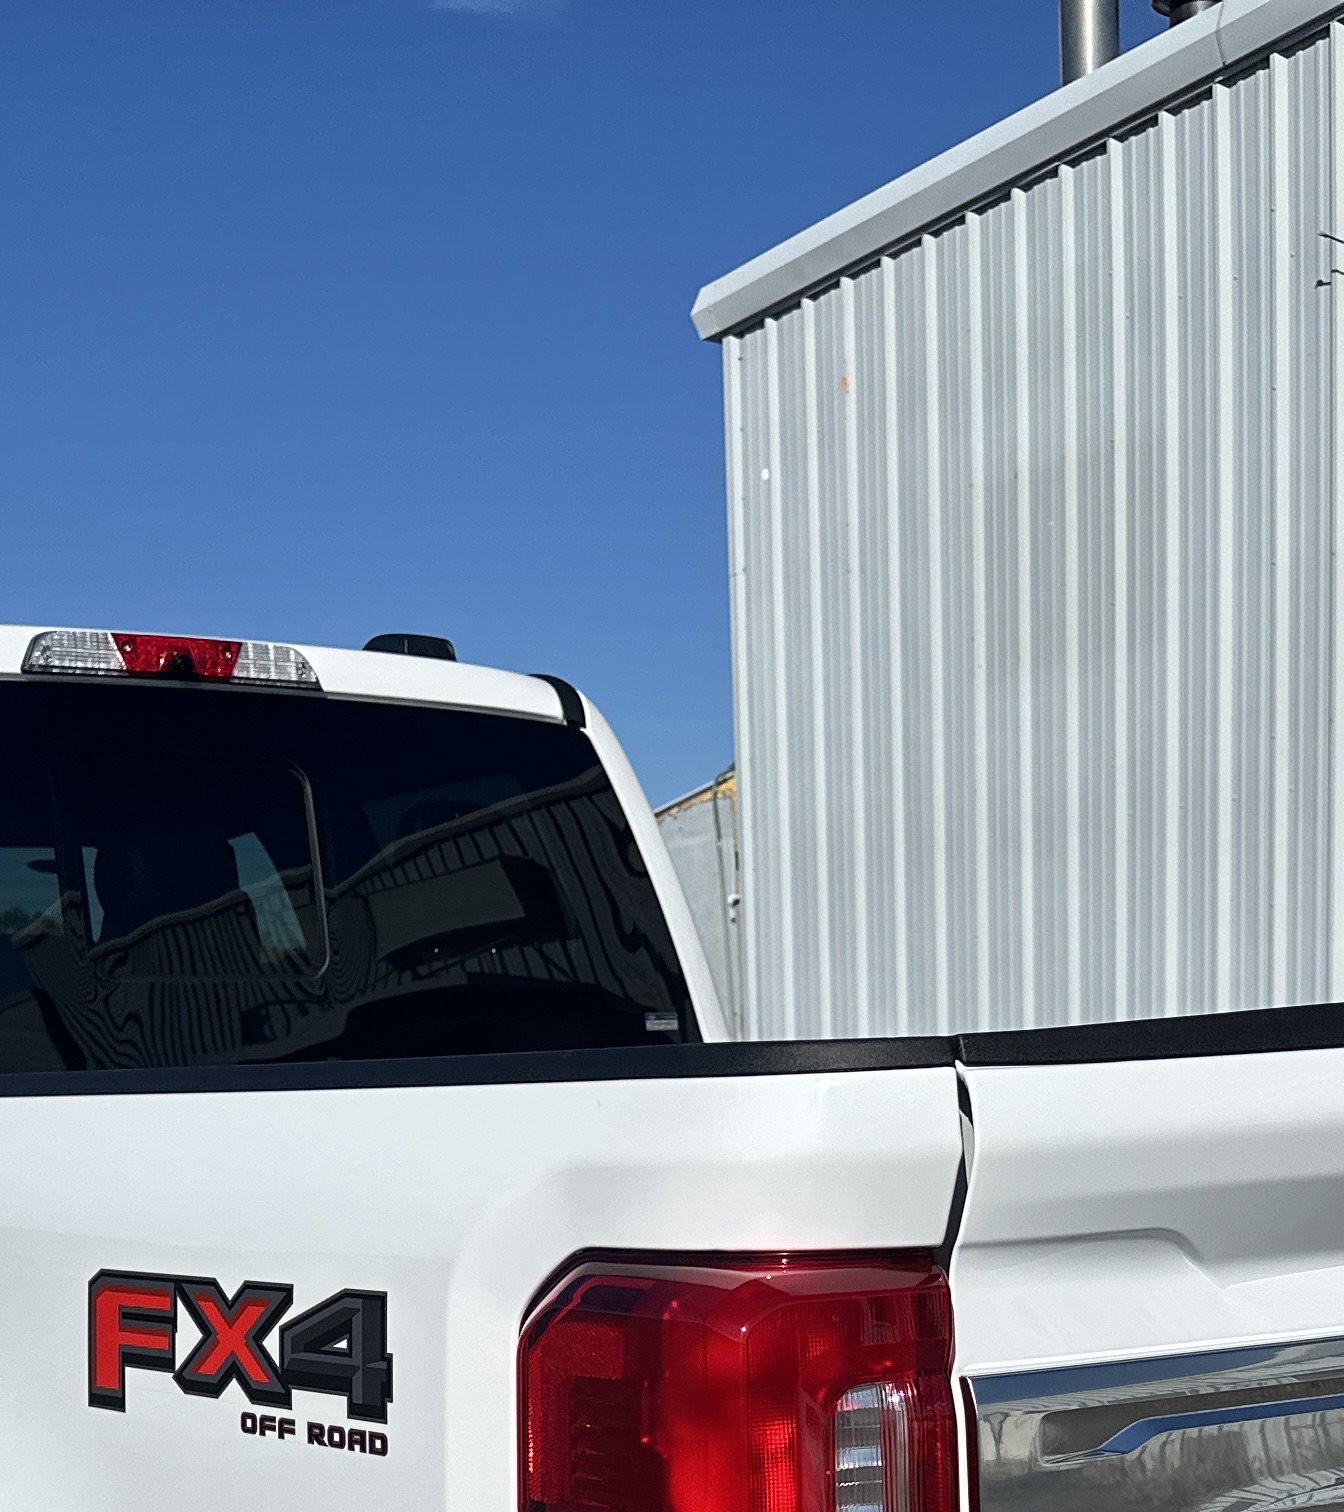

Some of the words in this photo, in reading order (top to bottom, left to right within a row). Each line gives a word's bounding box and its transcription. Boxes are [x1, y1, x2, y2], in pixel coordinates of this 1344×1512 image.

[87, 1267, 394, 1425] FX4
[240, 1410, 297, 1440] OFF
[305, 1420, 389, 1457] ROAD
